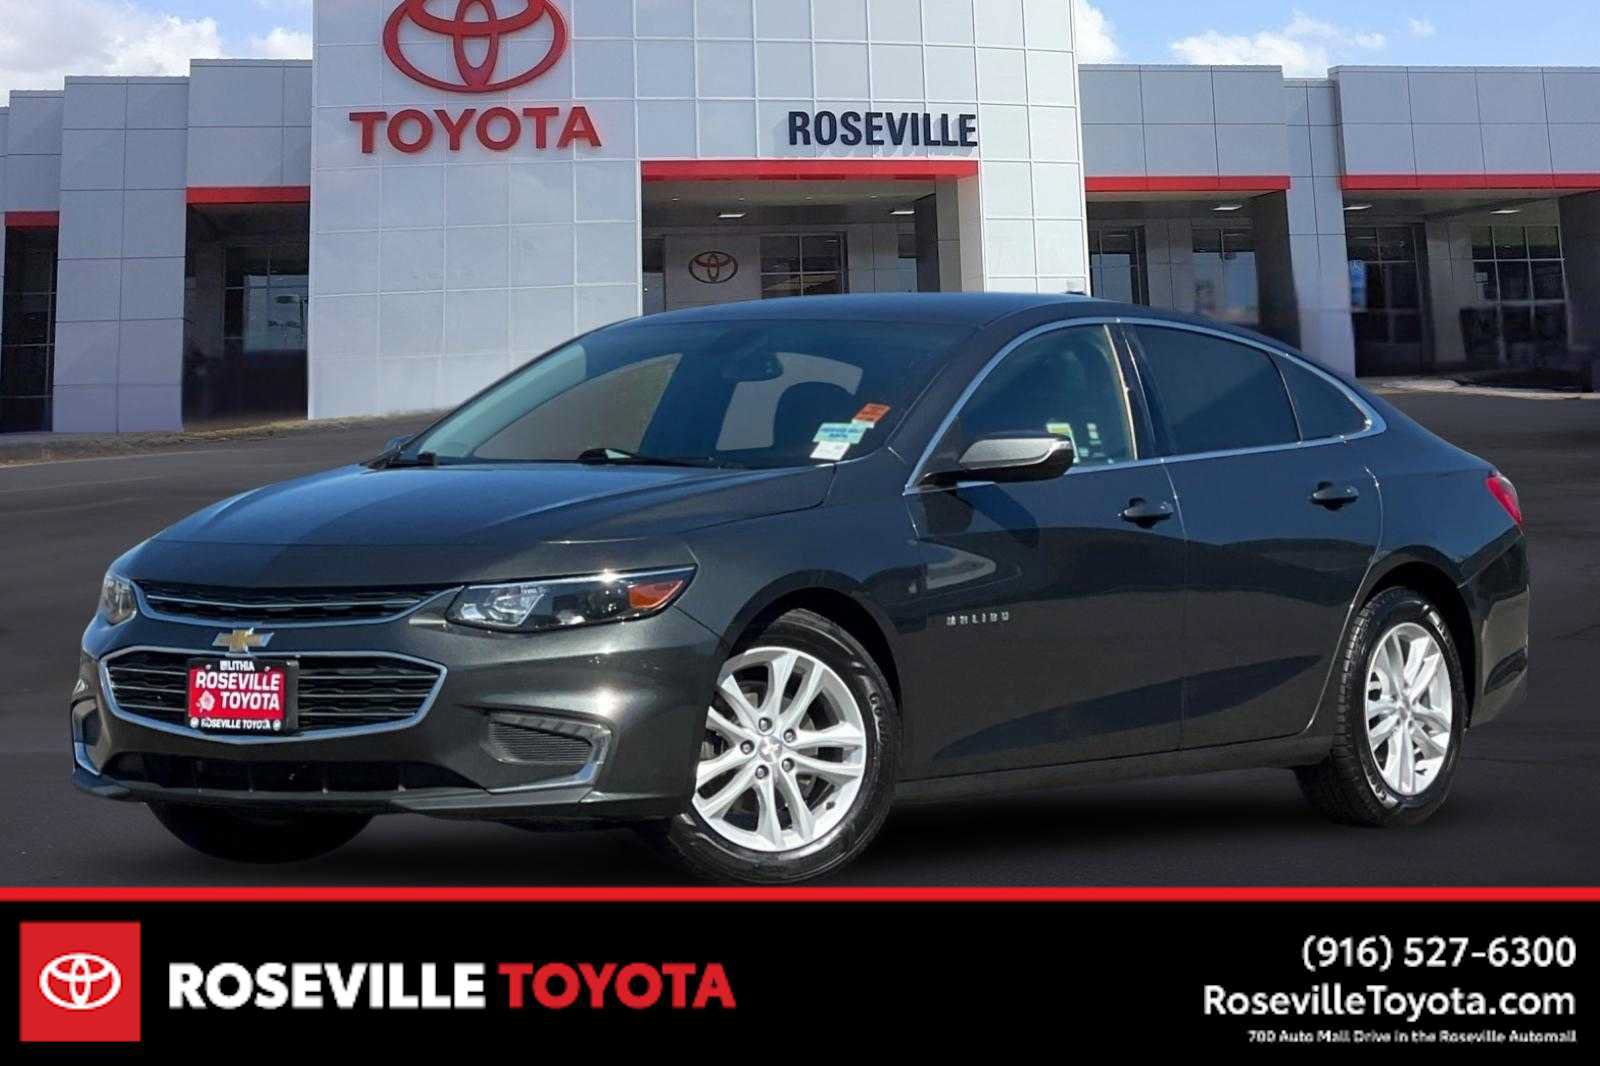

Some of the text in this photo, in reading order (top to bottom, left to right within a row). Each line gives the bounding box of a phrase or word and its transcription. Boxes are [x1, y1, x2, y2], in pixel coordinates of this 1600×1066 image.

[349, 106, 602, 153] TOYOTA
[788, 111, 978, 147] ROSEVILLE
[196, 672, 280, 690] ROSEVILLE
[221, 692, 280, 709] TOYOTA
[201, 718, 241, 728] ROSEVILLE
[242, 719, 271, 729] TOYOTA
